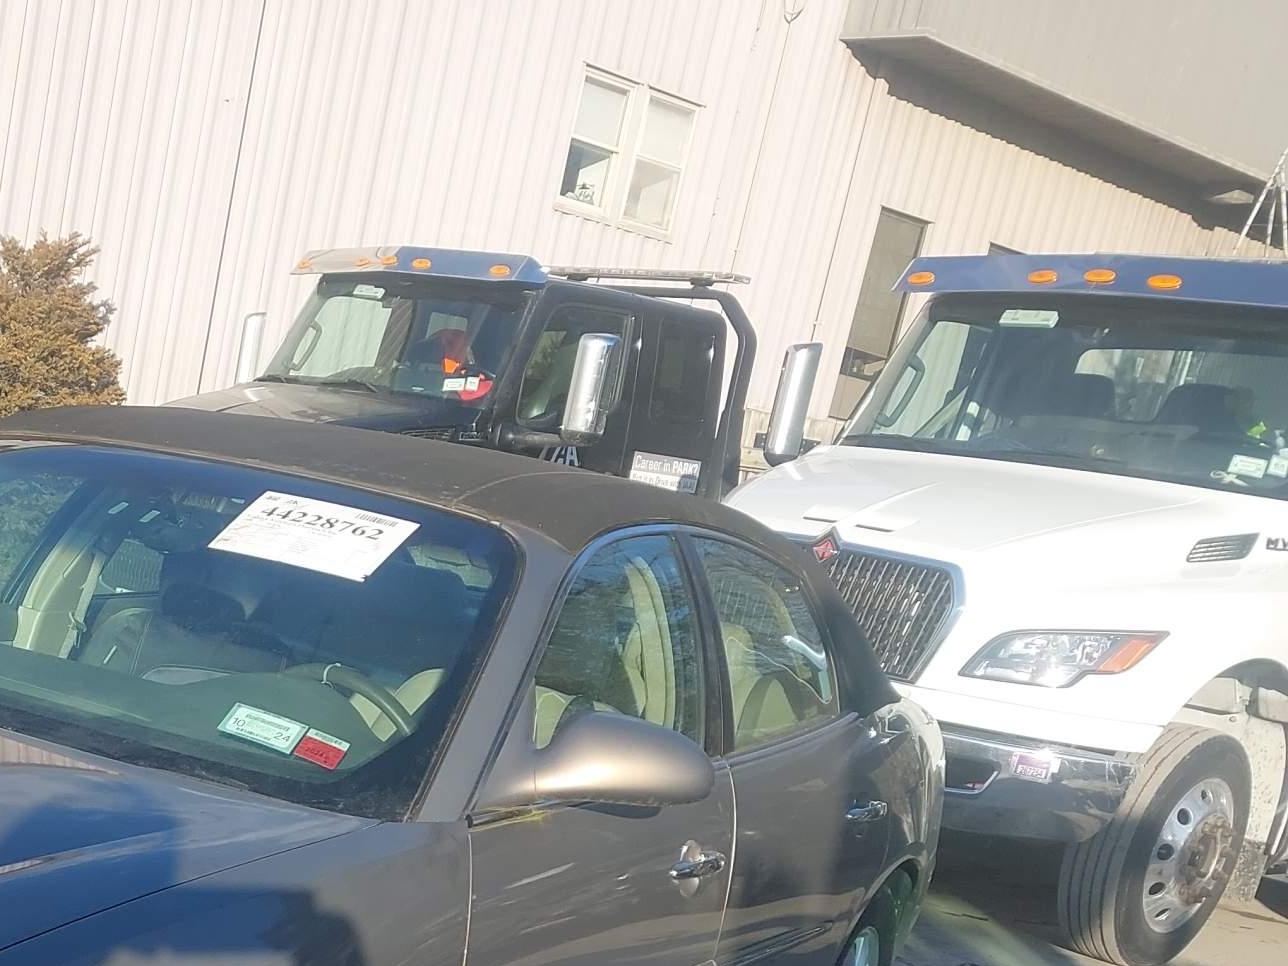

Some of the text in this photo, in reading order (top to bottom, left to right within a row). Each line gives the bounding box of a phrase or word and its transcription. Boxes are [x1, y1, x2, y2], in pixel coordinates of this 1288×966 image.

[636, 454, 699, 475] Career in PARK?
[261, 506, 384, 540] 44228762
[231, 717, 246, 728] 10
[273, 731, 291, 743] 24
